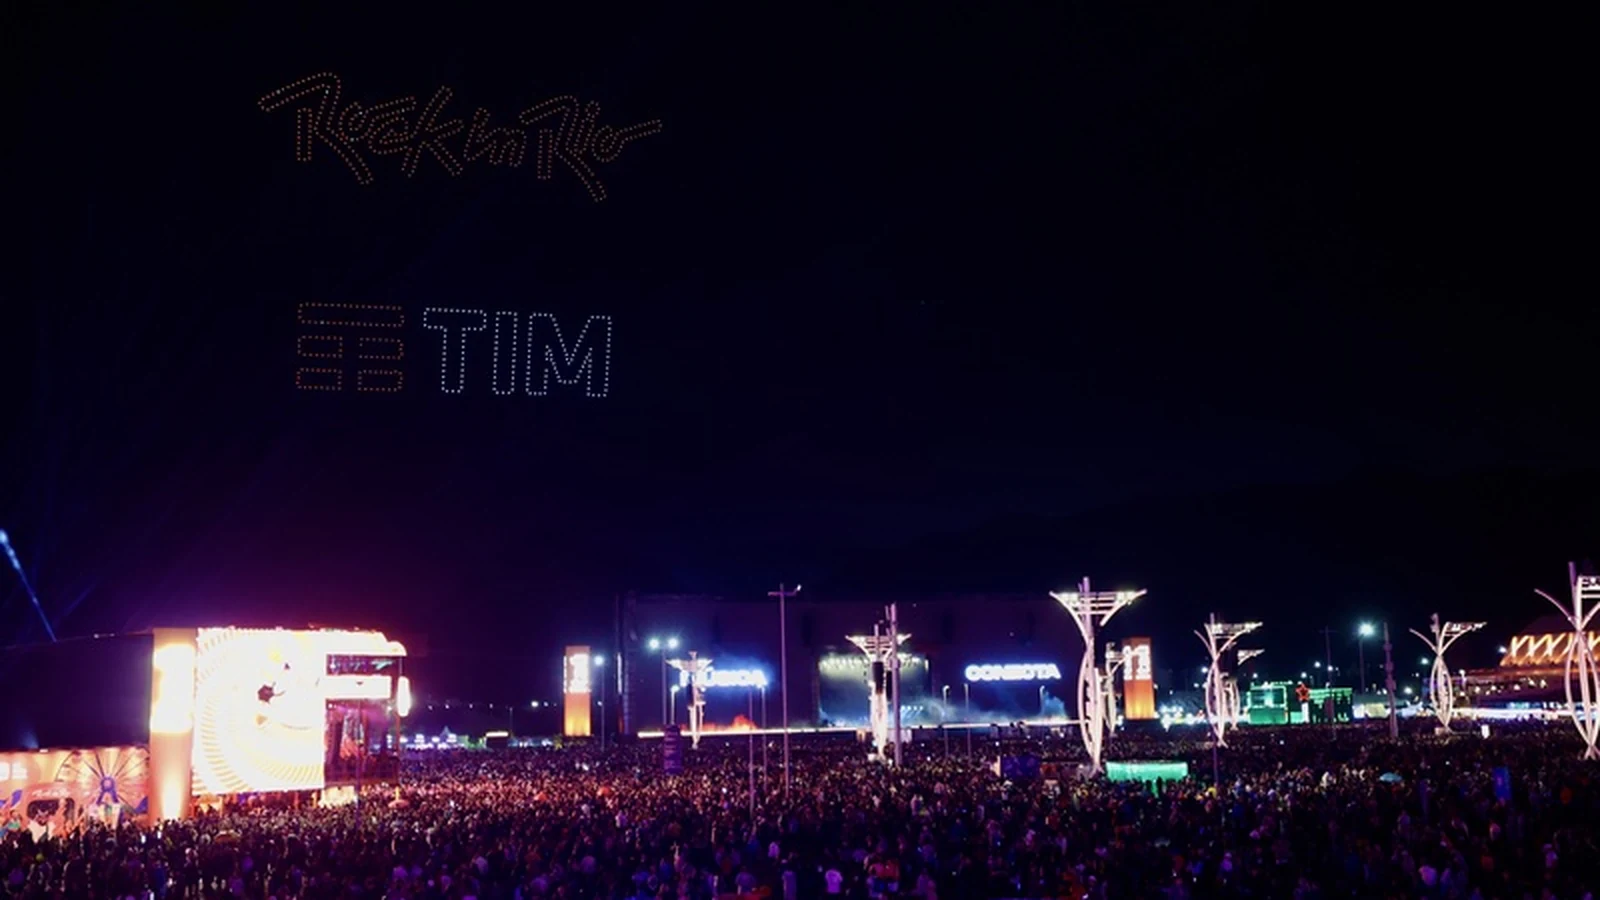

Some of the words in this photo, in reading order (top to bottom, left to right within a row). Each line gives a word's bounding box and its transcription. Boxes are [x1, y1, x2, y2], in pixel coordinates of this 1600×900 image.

[258, 72, 465, 185] Rock
[518, 95, 663, 202] Rio
[423, 307, 612, 396] TIM
